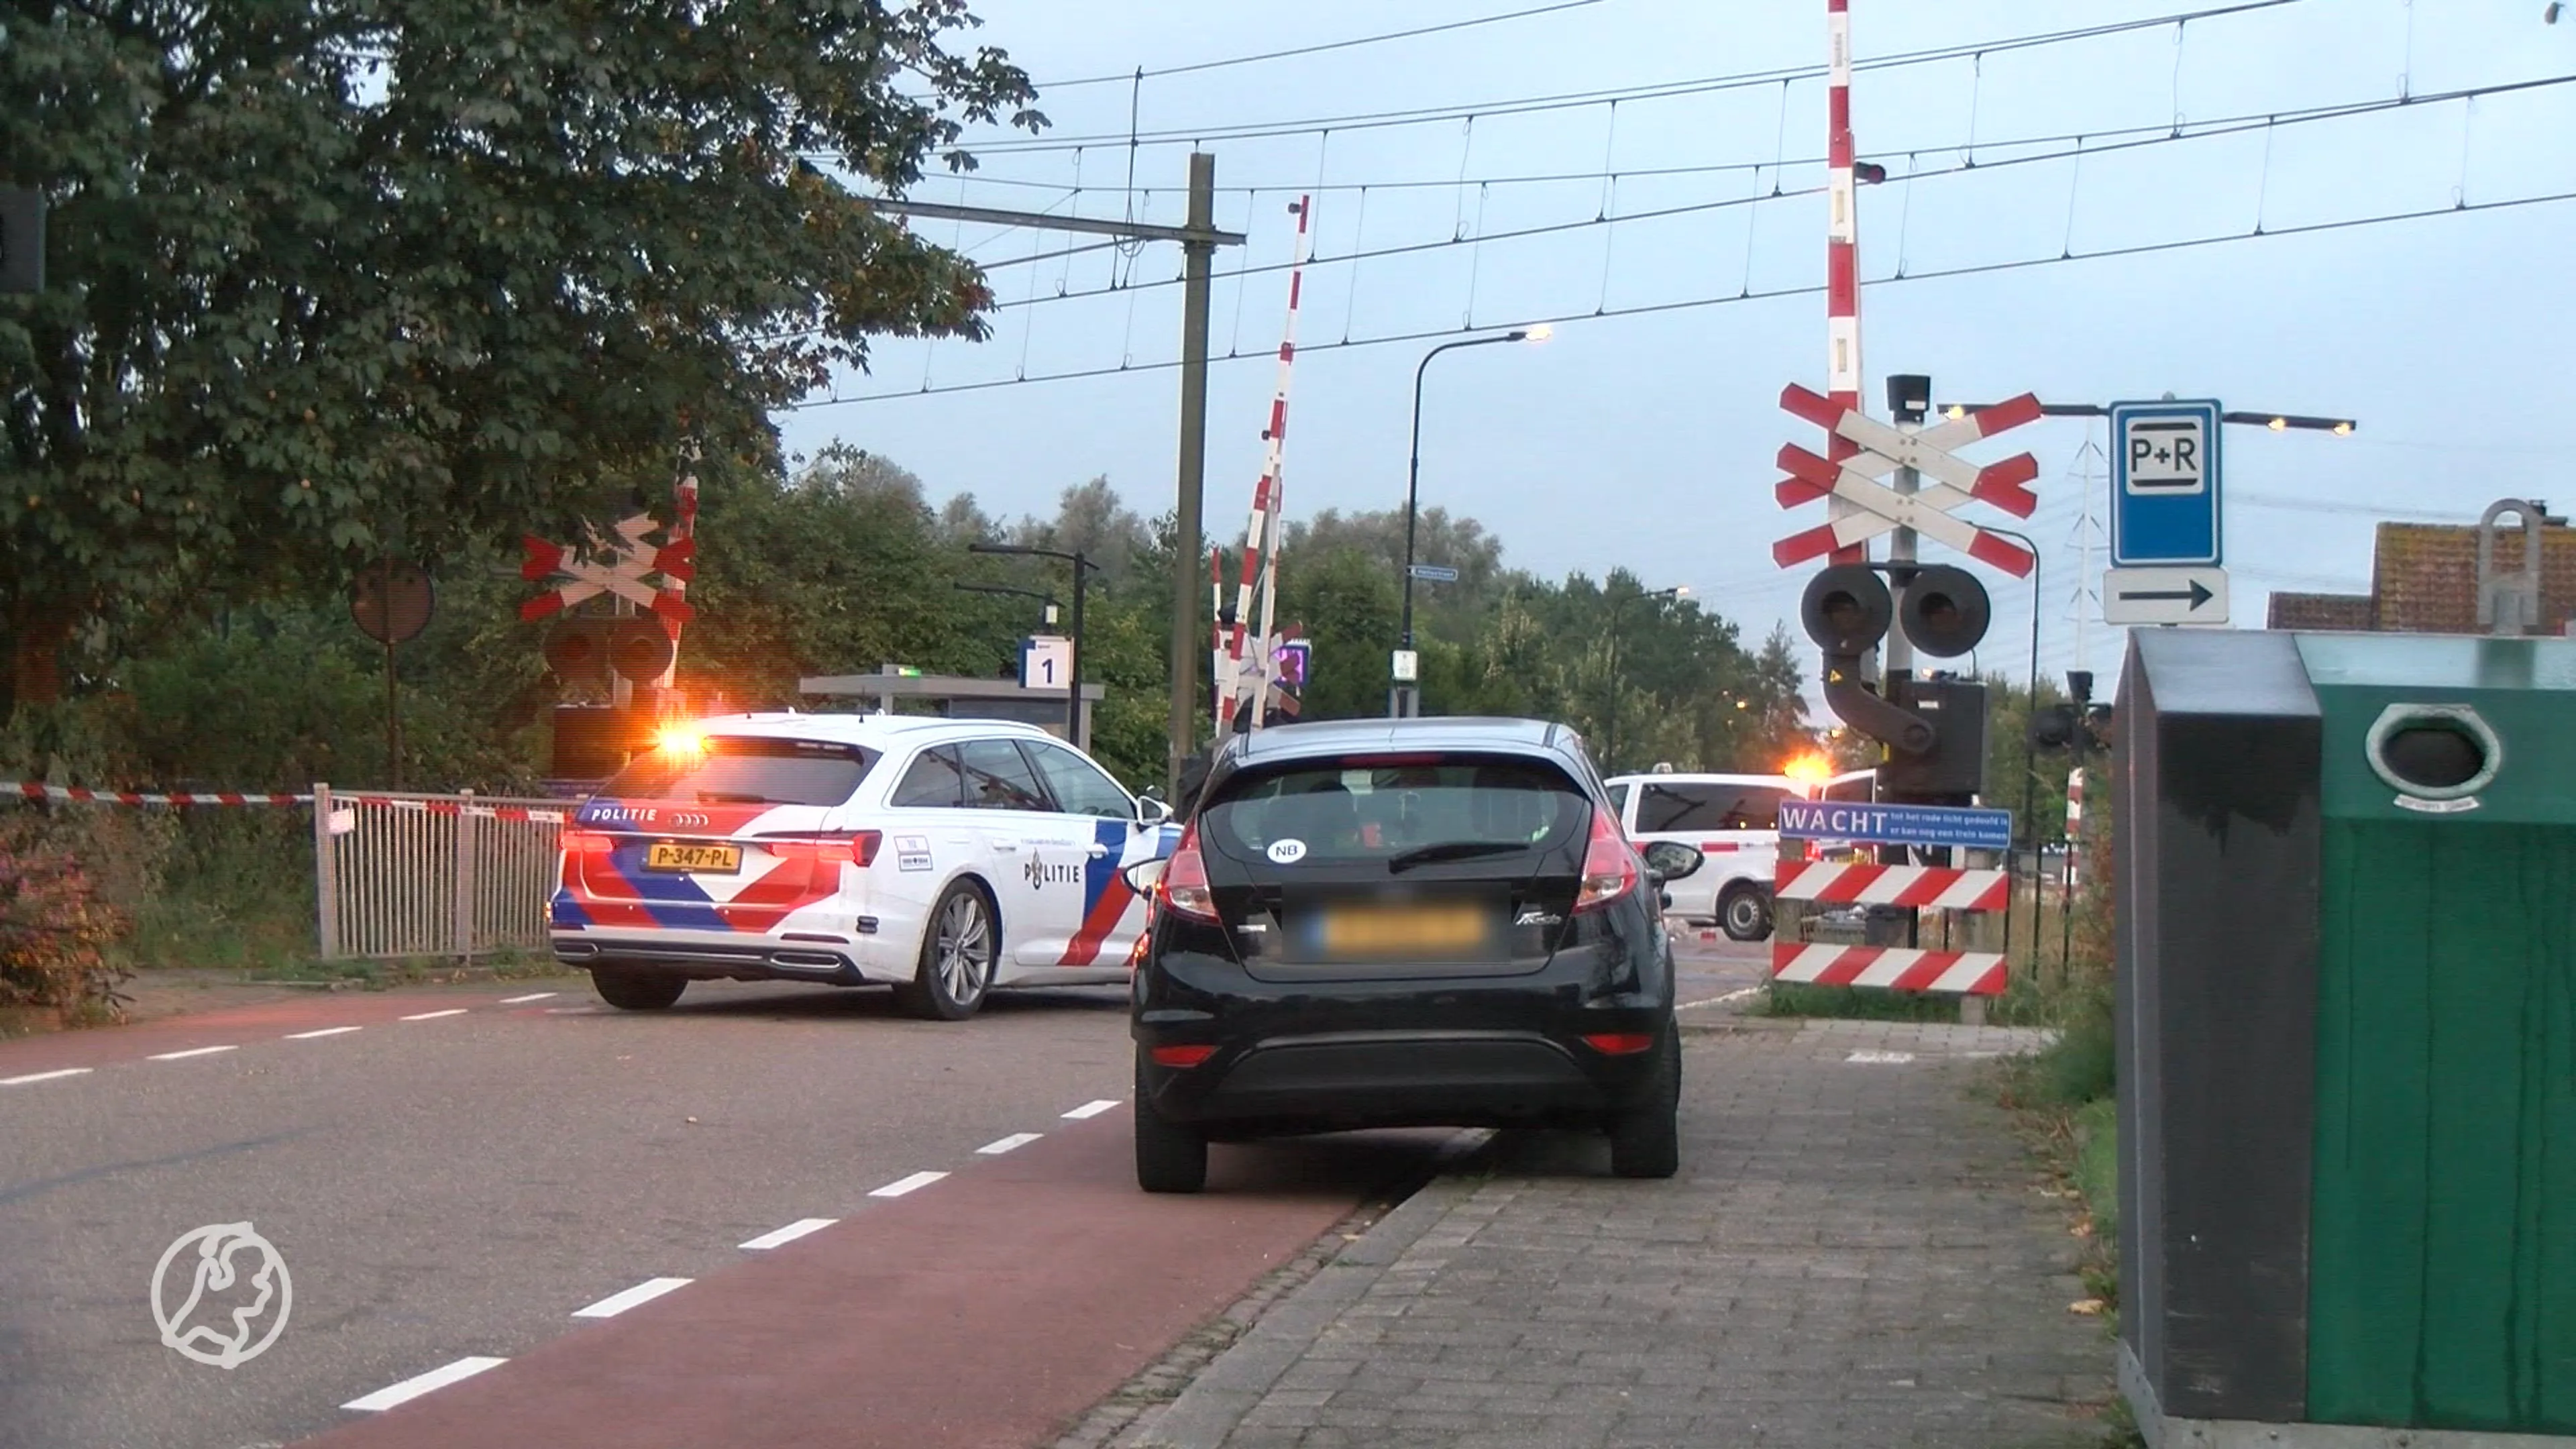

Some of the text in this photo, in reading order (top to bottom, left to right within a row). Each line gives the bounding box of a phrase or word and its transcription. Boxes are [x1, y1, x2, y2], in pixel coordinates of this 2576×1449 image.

[2131, 438, 2197, 472] P+R
[1041, 658, 1053, 684] 1
[591, 808, 657, 821] POLITIE
[1782, 807, 1888, 834] WACHT
[656, 847, 732, 867] P-347-PL
[1275, 845, 1298, 857] NB
